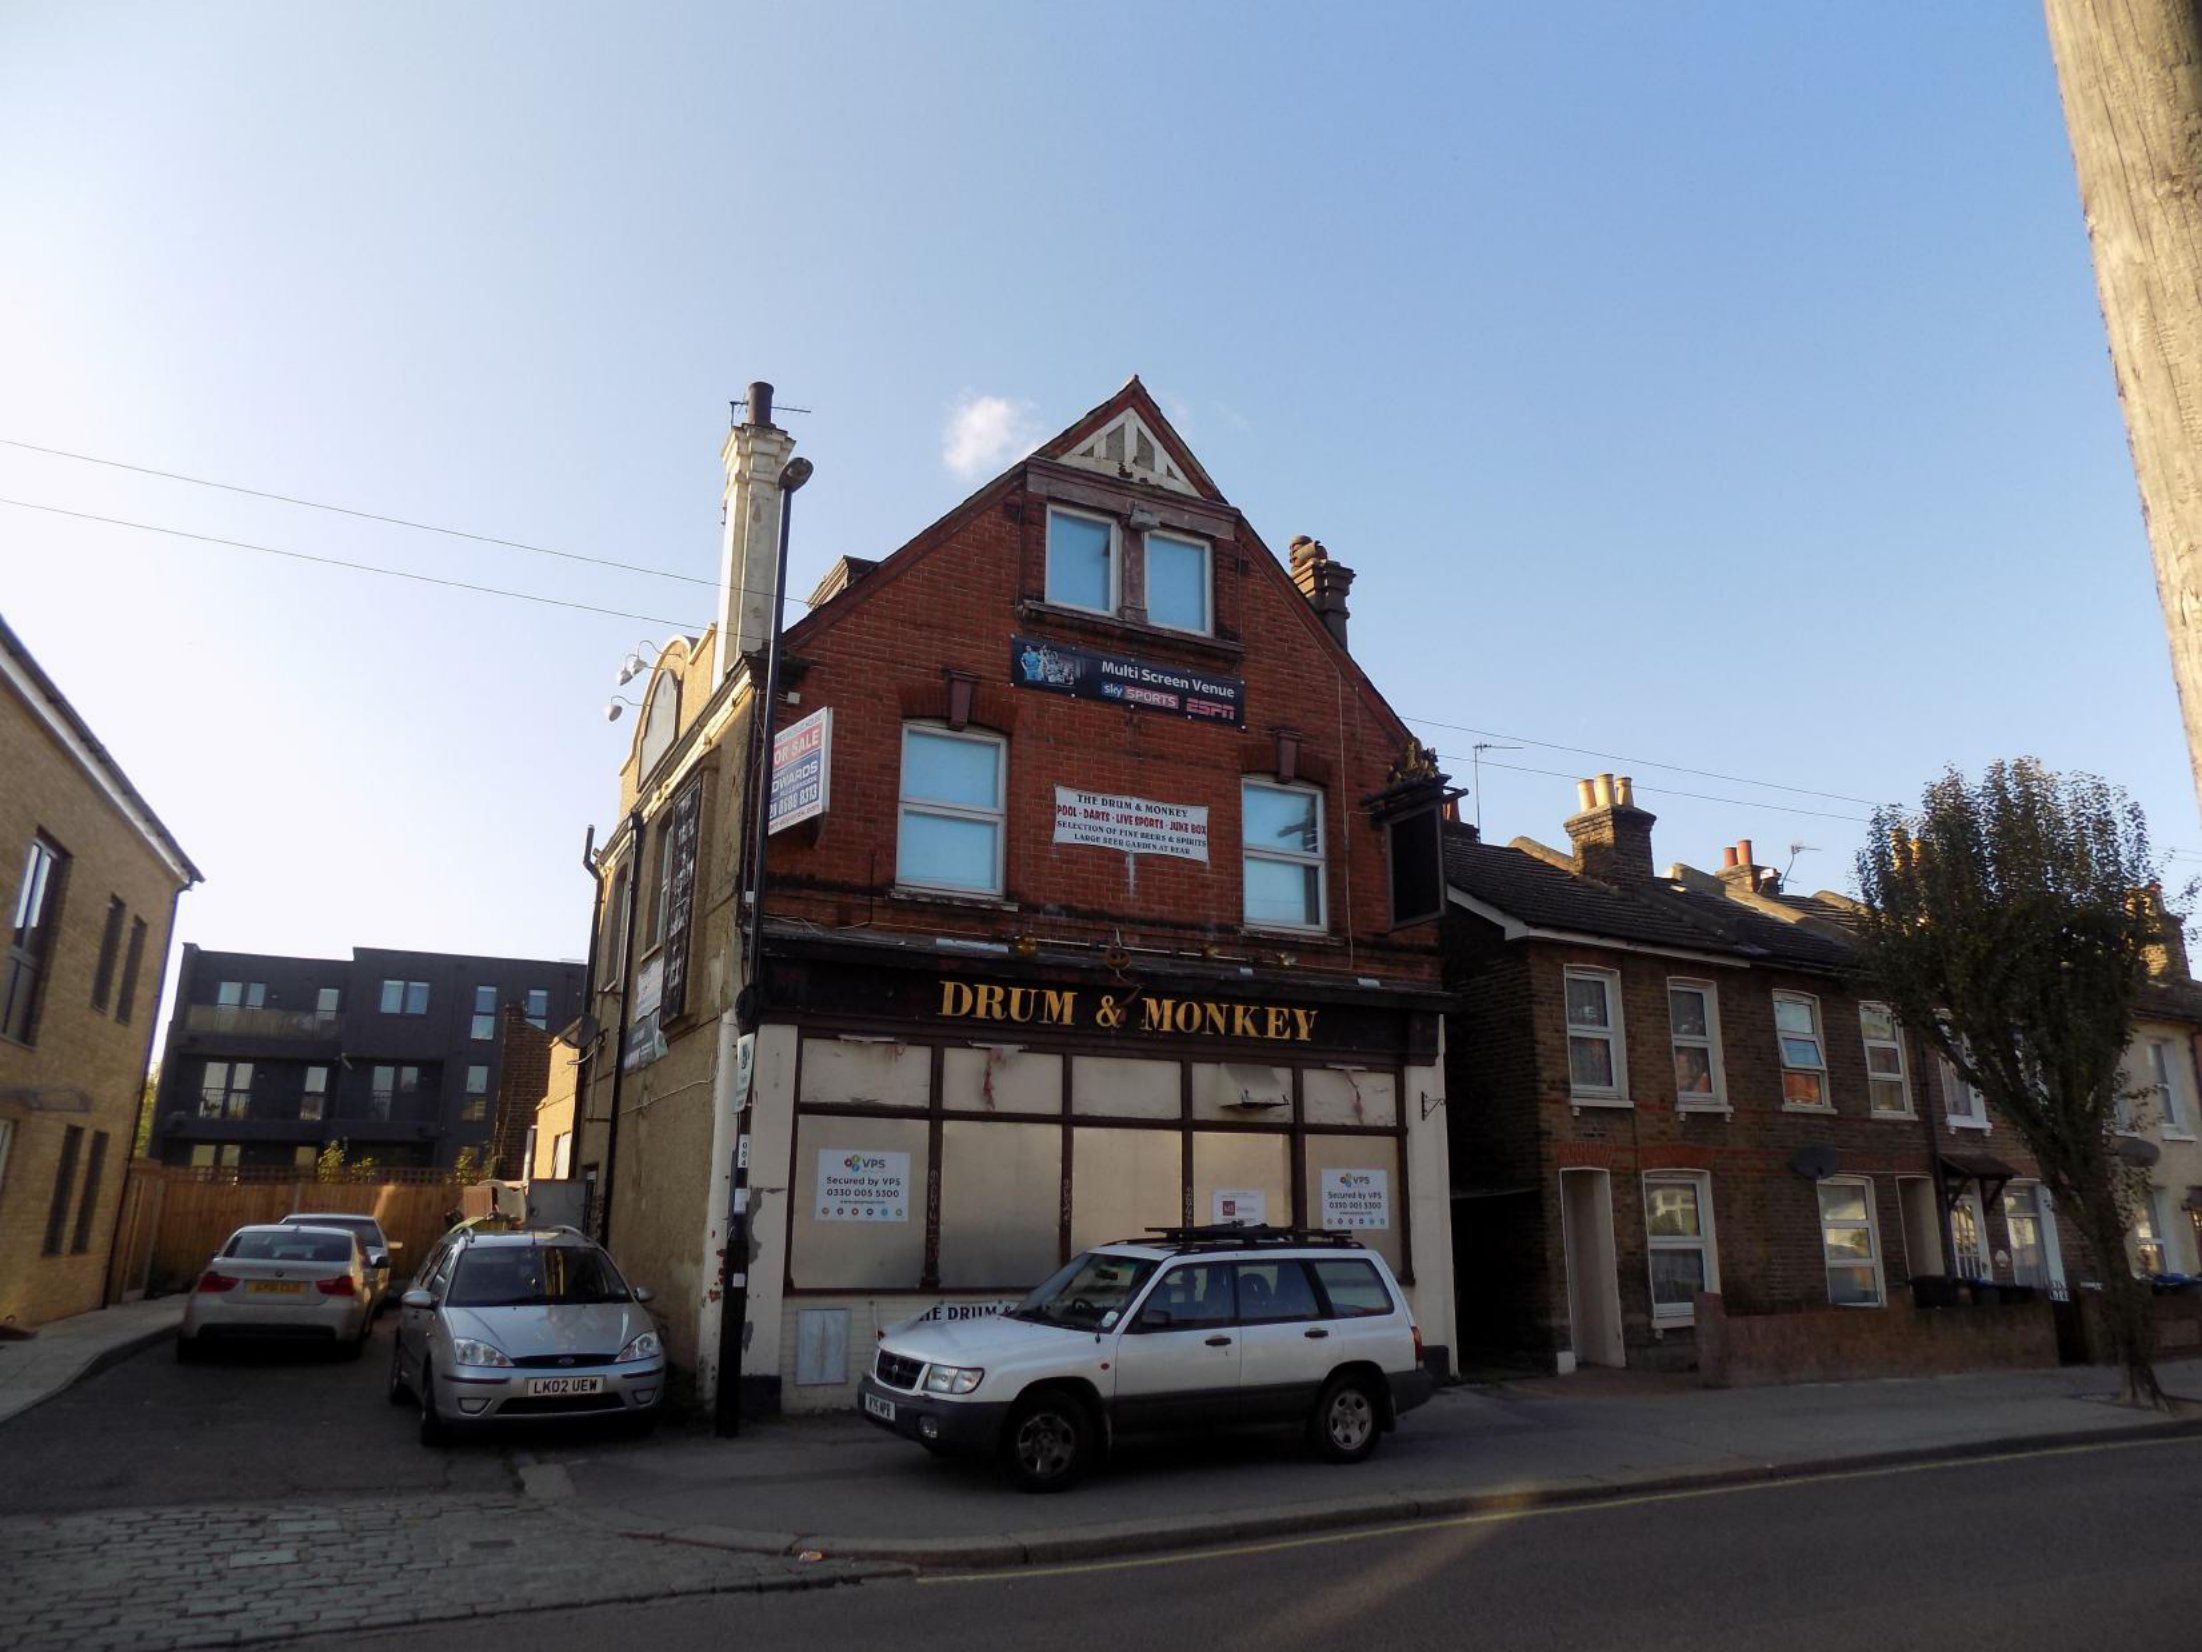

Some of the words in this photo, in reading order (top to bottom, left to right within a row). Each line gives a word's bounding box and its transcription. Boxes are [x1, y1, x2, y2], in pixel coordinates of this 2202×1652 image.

[1102, 660, 1138, 679] Multi
[1141, 668, 1189, 689] Screen
[1192, 679, 1235, 698] Venue
[1104, 683, 1123, 698] sky
[1125, 686, 1176, 707] SPORTS
[1186, 698, 1235, 720] ESPN
[791, 730, 820, 757] SALE
[1077, 794, 1098, 805] THE
[1101, 798, 1132, 809] DRUM
[1134, 803, 1142, 811] &
[1145, 804, 1188, 817] MONKEY
[1057, 805, 1077, 817] POOL
[1083, 809, 1110, 822] DARTS
[1116, 814, 1133, 826] LIVE
[1134, 816, 1164, 829] SPORTS
[1170, 821, 1189, 833] JUKE
[1191, 823, 1207, 836] BOX
[1057, 821, 1104, 833] SELECTION
[1105, 827, 1116, 835] OF
[1120, 829, 1138, 837] FINE
[1140, 832, 1166, 841] BEERS
[1176, 837, 1207, 847] SPIRITS
[1074, 833, 1100, 843] LARGE
[1102, 837, 1124, 846] BEER
[1125, 841, 1157, 850] GARDEN
[1170, 846, 1191, 854] REAR
[936, 980, 1078, 1026] DRUM
[1095, 995, 1121, 1028] &
[1142, 997, 1319, 1042] MONKEY
[862, 1159, 887, 1169] VPS
[826, 1176, 865, 1185] Secured
[867, 1177, 879, 1186] by
[882, 1178, 901, 1186] VPS
[1353, 1176, 1370, 1184] VPS
[826, 1188, 852, 1197] 0330
[875, 1189, 900, 1198] 5300
[1327, 1191, 1356, 1199] Secured
[1358, 1191, 1367, 1200] by
[947, 1306, 997, 1321] DRUM
[534, 1380, 569, 1394] LK02
[571, 1378, 598, 1392] UEW
